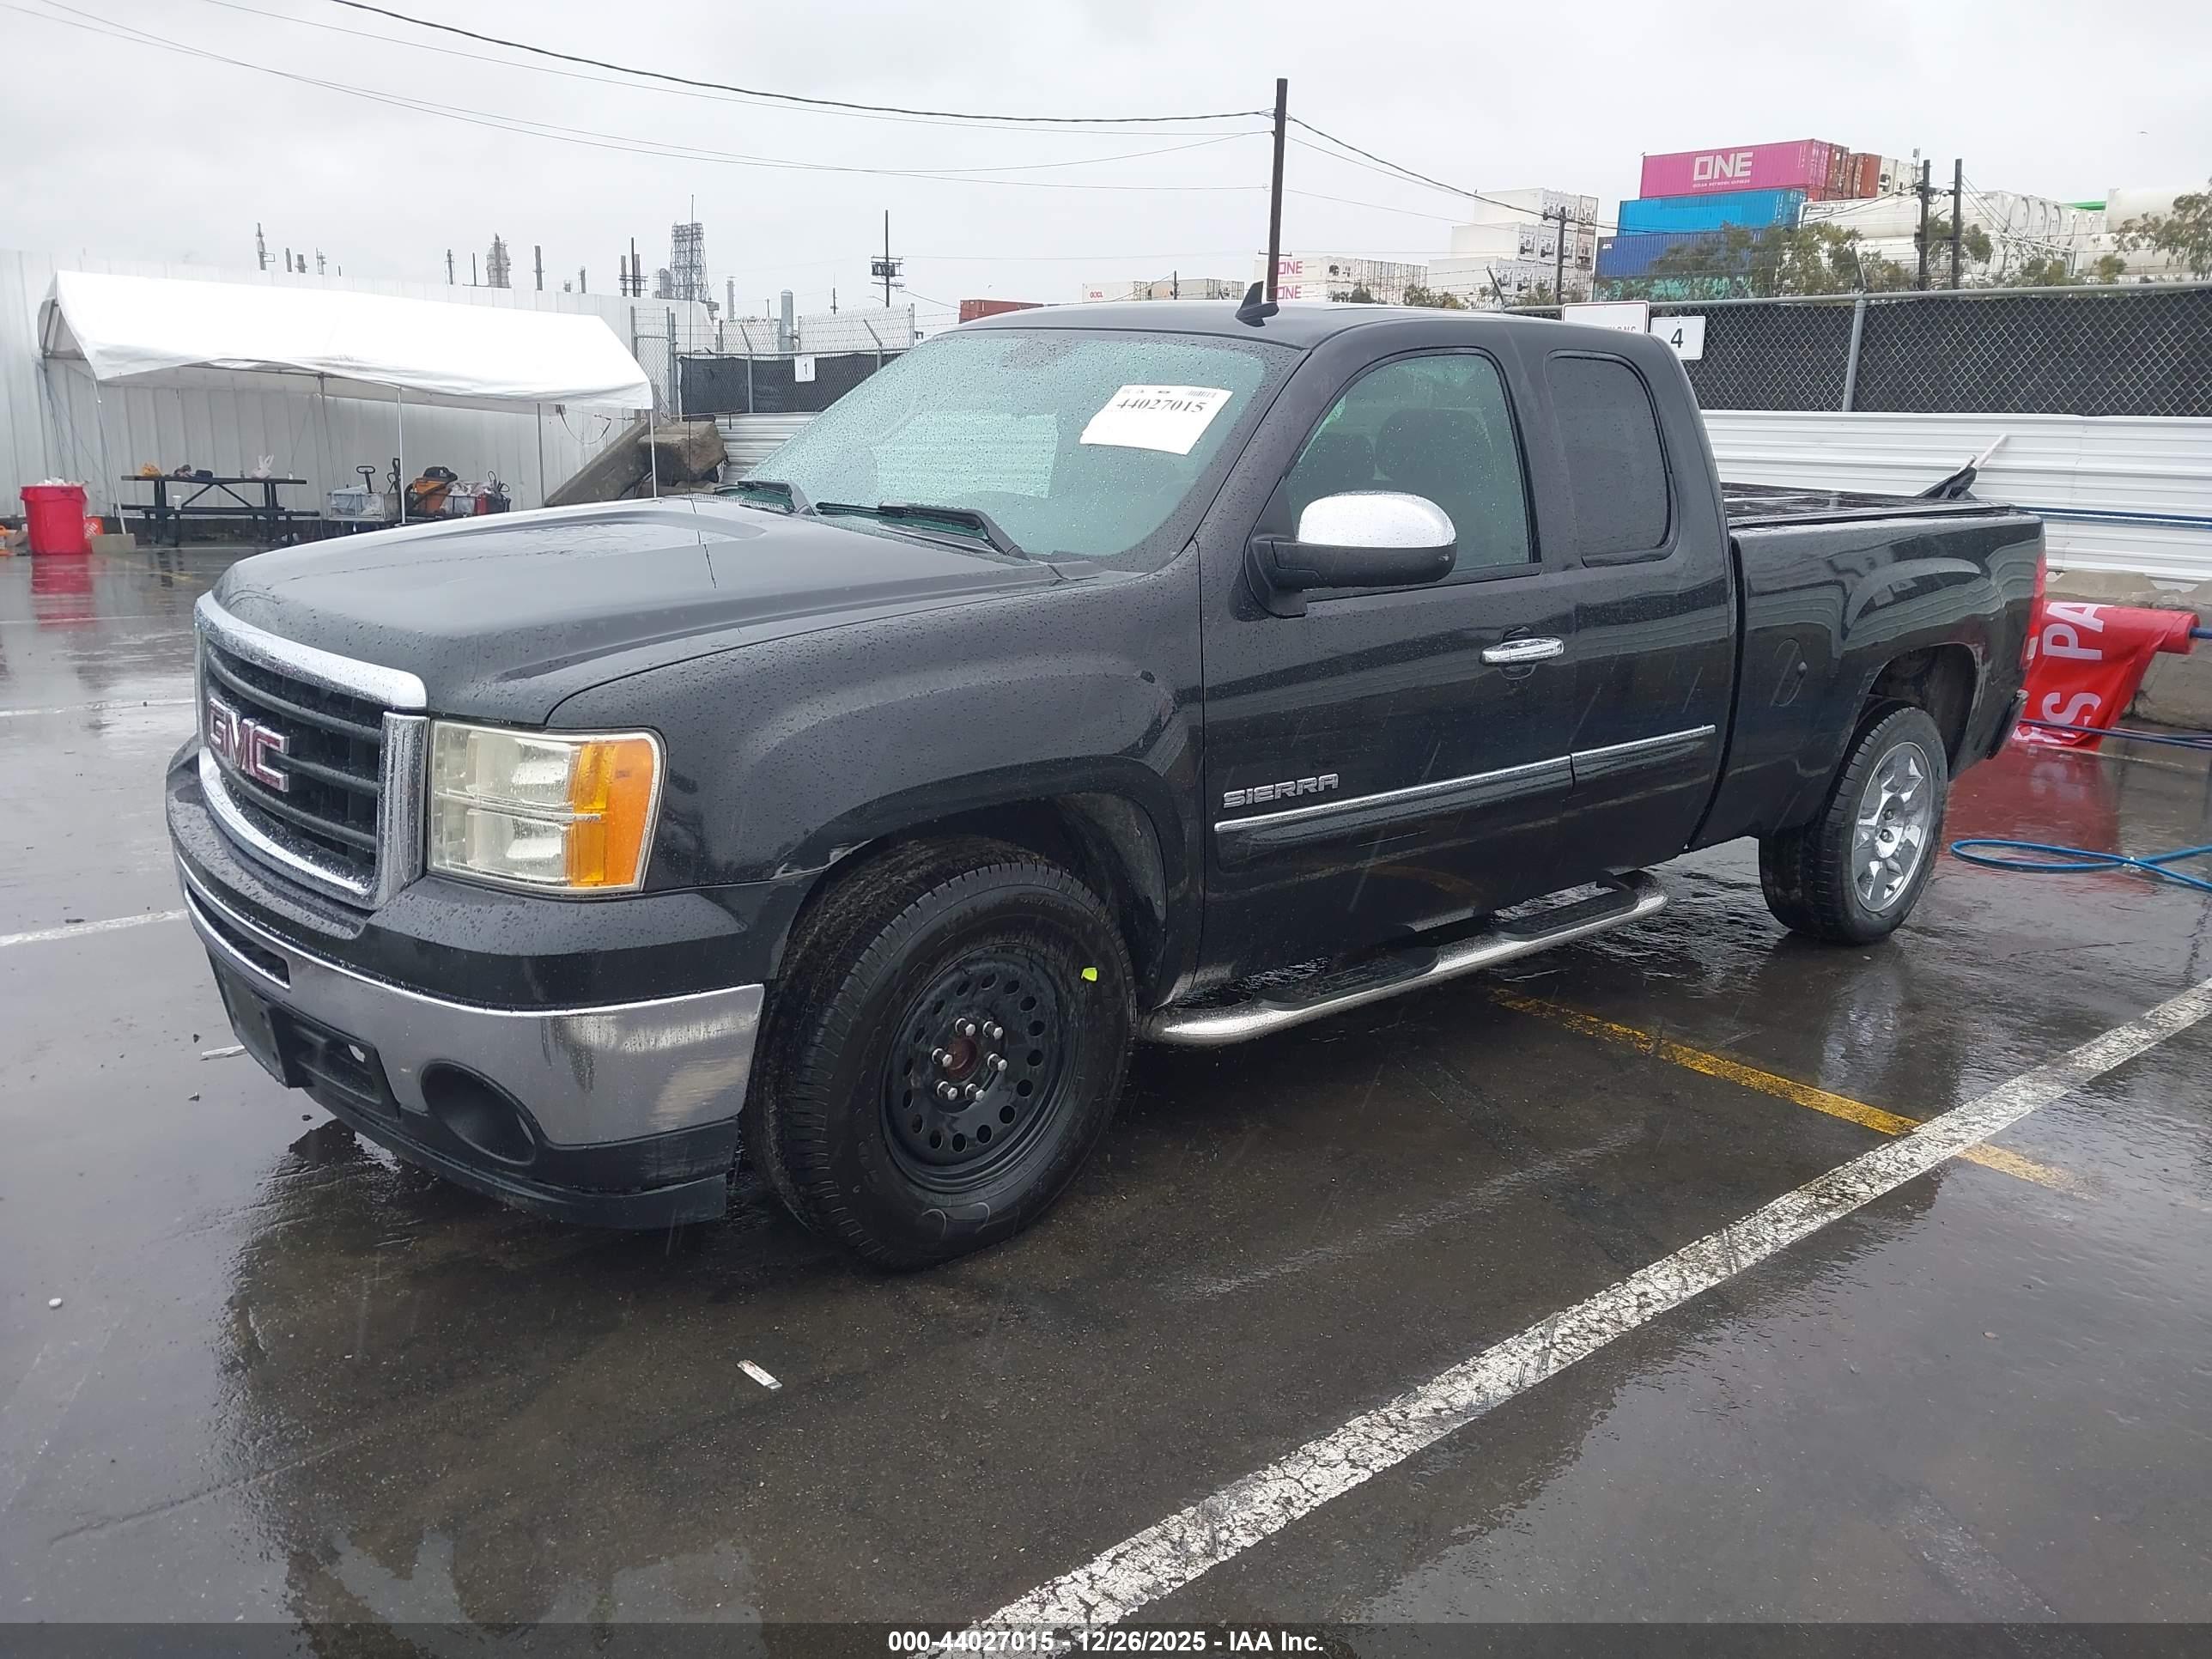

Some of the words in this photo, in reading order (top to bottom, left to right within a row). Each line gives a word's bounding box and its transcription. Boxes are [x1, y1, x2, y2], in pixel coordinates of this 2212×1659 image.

[1693, 152, 1753, 180] ONE
[1670, 328, 1684, 349] 4
[1116, 398, 1208, 413] 44027015
[207, 697, 289, 793] GMC
[1223, 773, 1340, 809] SIERRA
